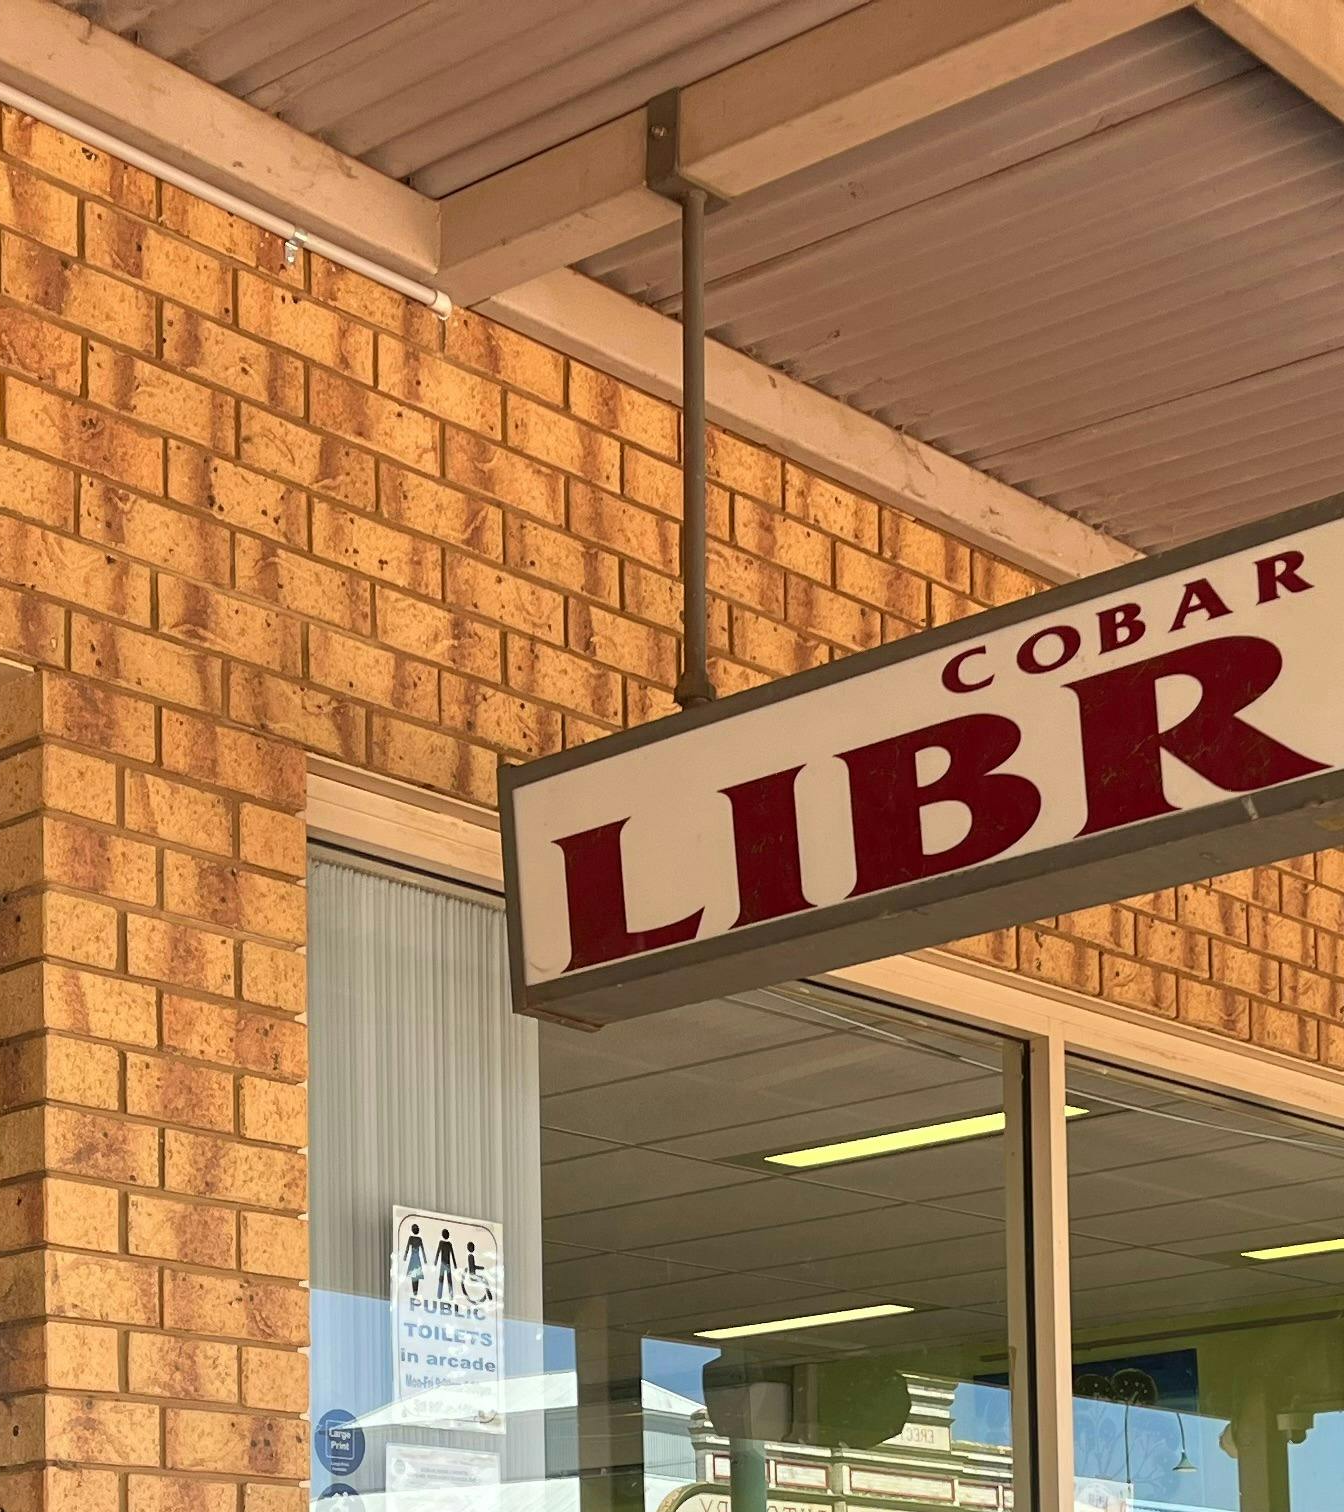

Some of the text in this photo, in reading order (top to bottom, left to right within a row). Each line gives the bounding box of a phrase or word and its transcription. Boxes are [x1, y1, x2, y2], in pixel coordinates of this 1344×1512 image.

[941, 549, 1314, 694] COBAR
[408, 1297, 487, 1321] PUBLIC
[403, 1321, 493, 1347] TOILETS
[400, 1347, 496, 1373] in arcade
[330, 1440, 350, 1451] Print
